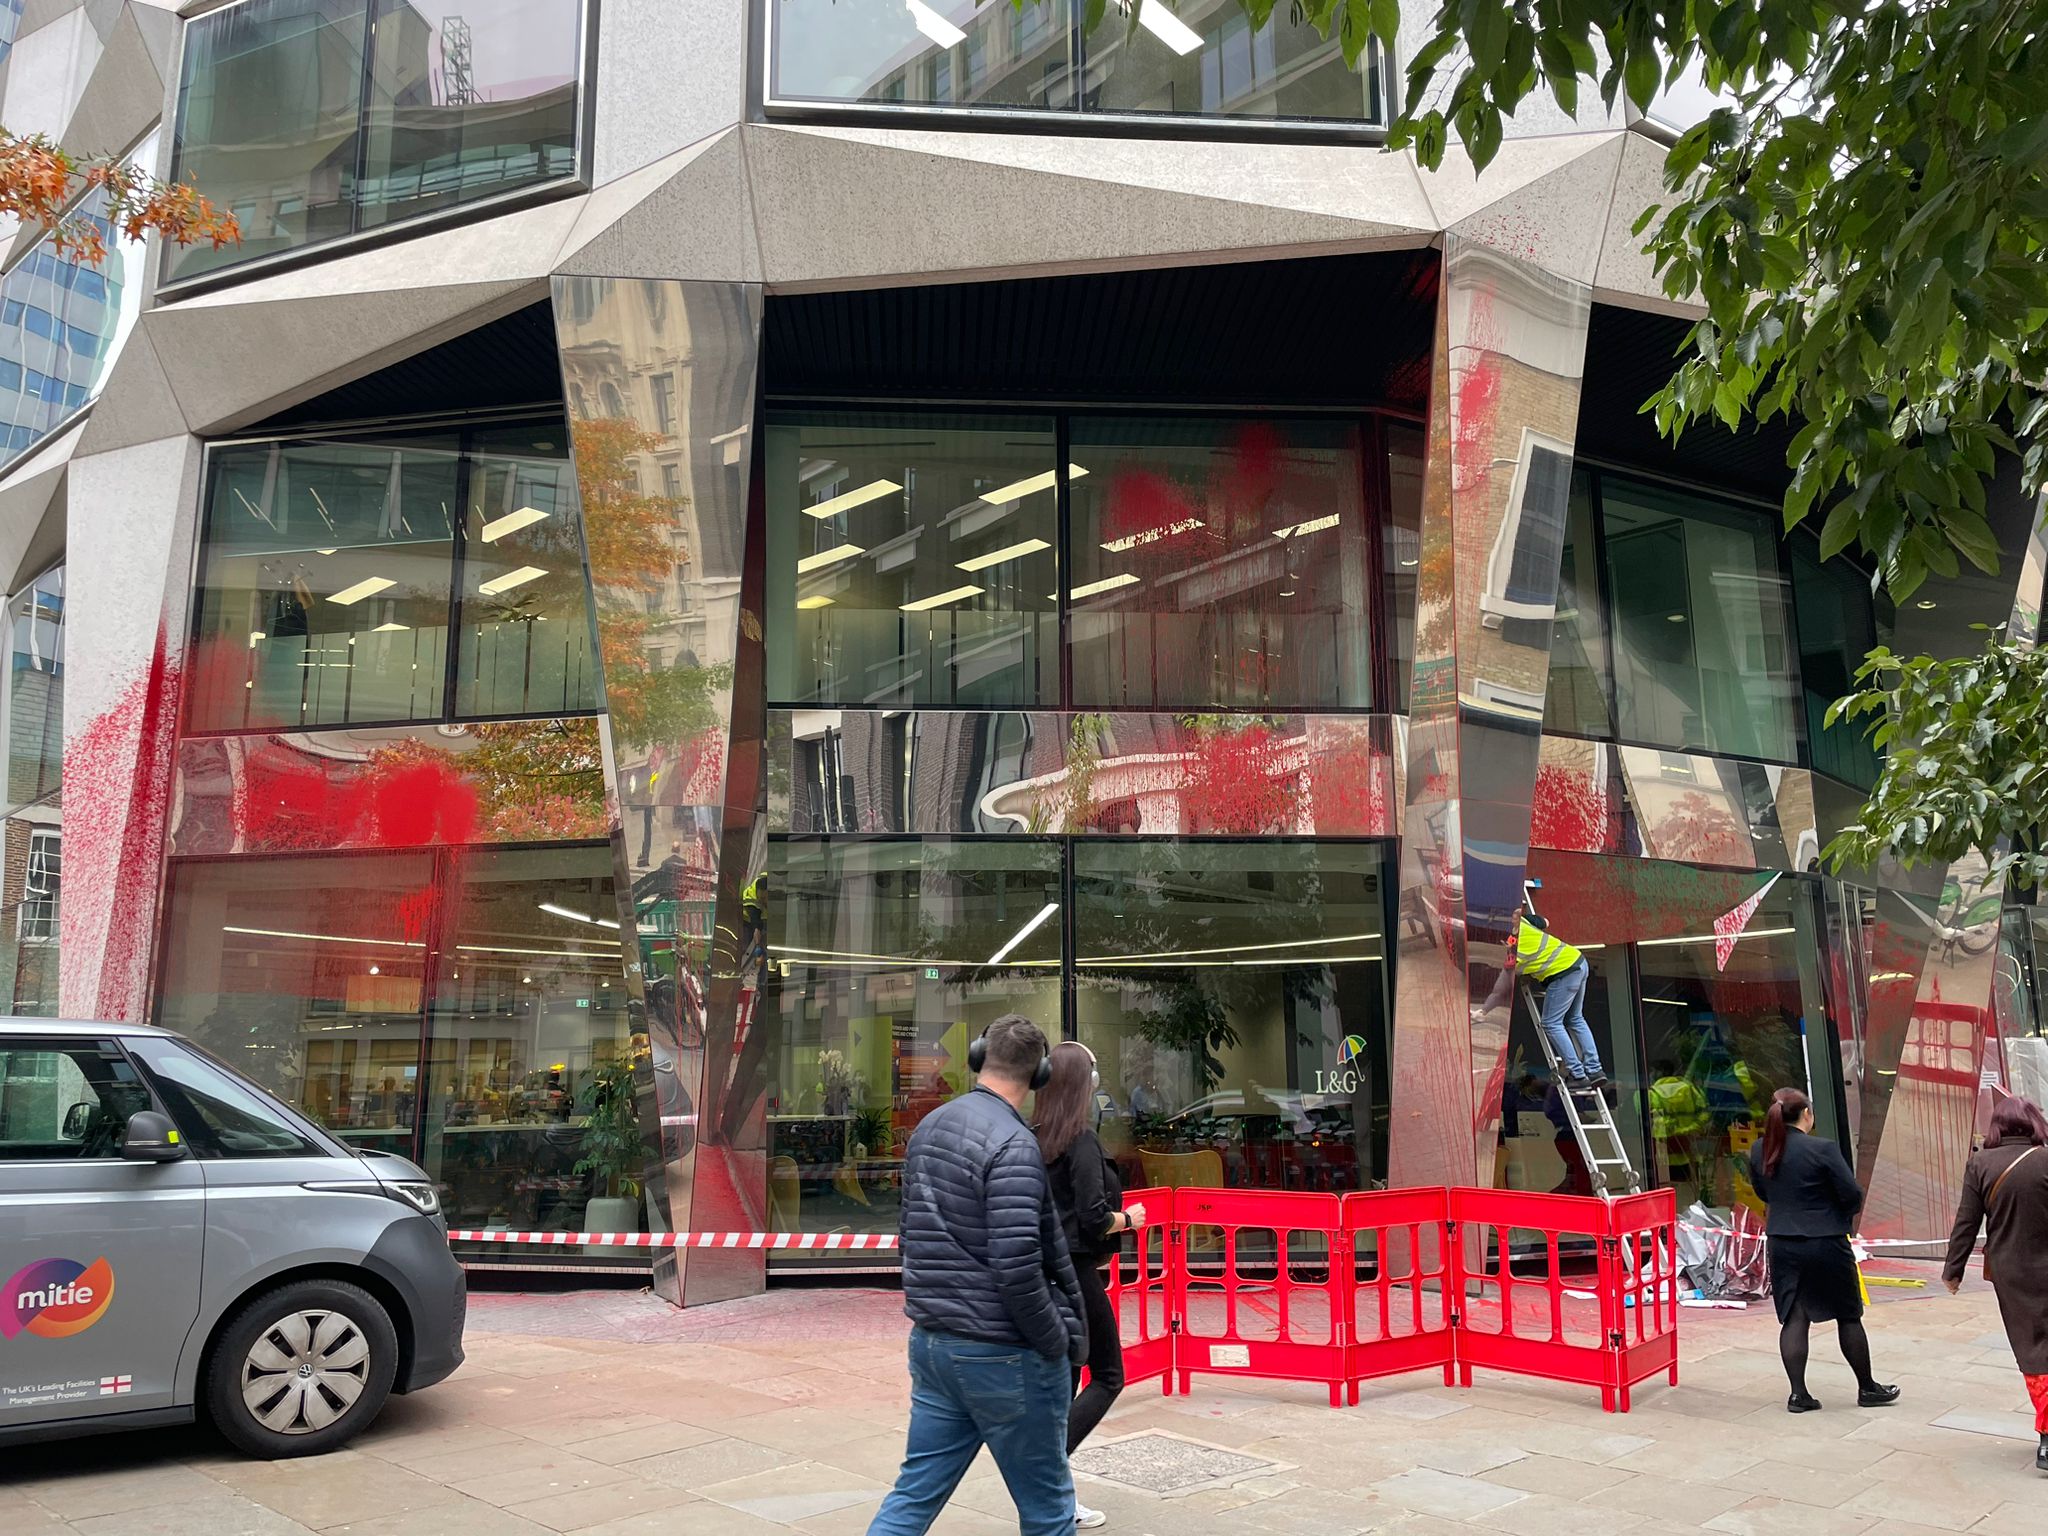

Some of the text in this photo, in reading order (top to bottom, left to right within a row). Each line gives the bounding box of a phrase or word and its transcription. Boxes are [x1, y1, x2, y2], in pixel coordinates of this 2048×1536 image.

[1315, 1070, 1357, 1094] L&G
[18, 1281, 94, 1309] mitie
[2, 1379, 96, 1395] The UK's Leading Facilities
[9, 1391, 87, 1405] Management Provider
